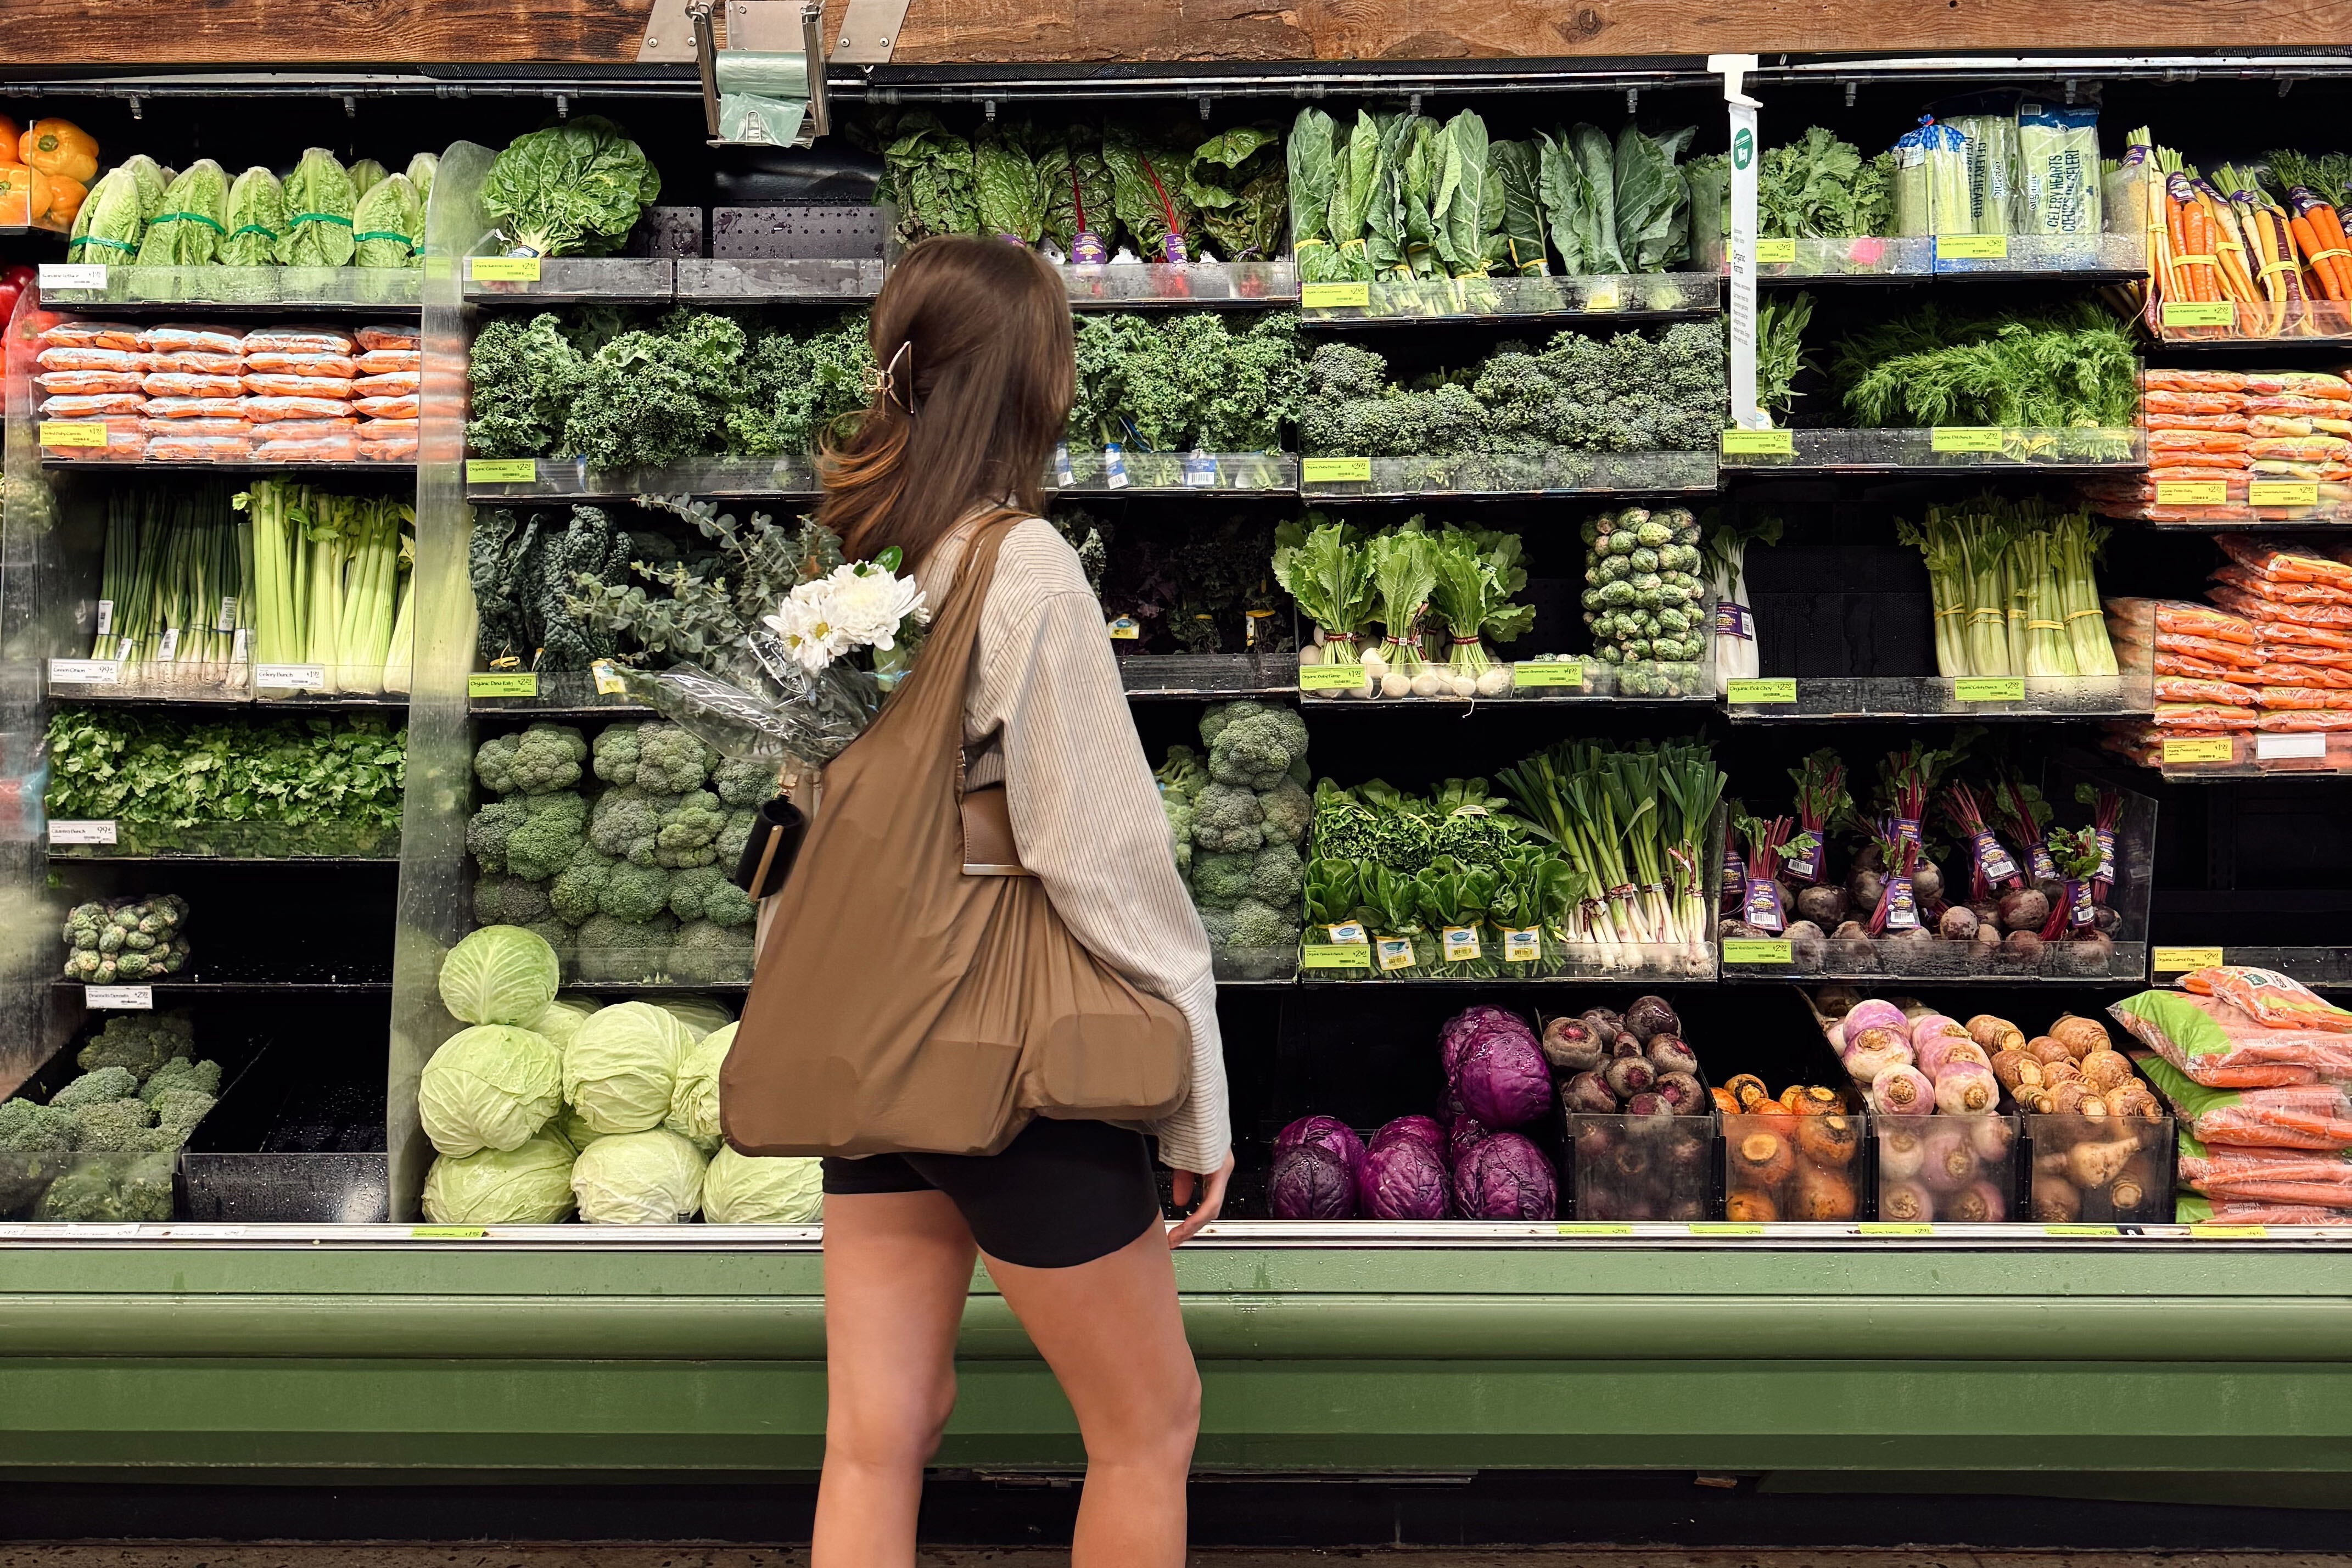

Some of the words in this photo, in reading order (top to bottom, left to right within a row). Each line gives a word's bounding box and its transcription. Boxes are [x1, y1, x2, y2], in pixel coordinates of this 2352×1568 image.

[1975, 142, 1987, 177] CELERY
[2048, 155, 2063, 189] HEARTS
[1973, 180, 1984, 219] HEARTS
[2046, 192, 2063, 227] CELERY
